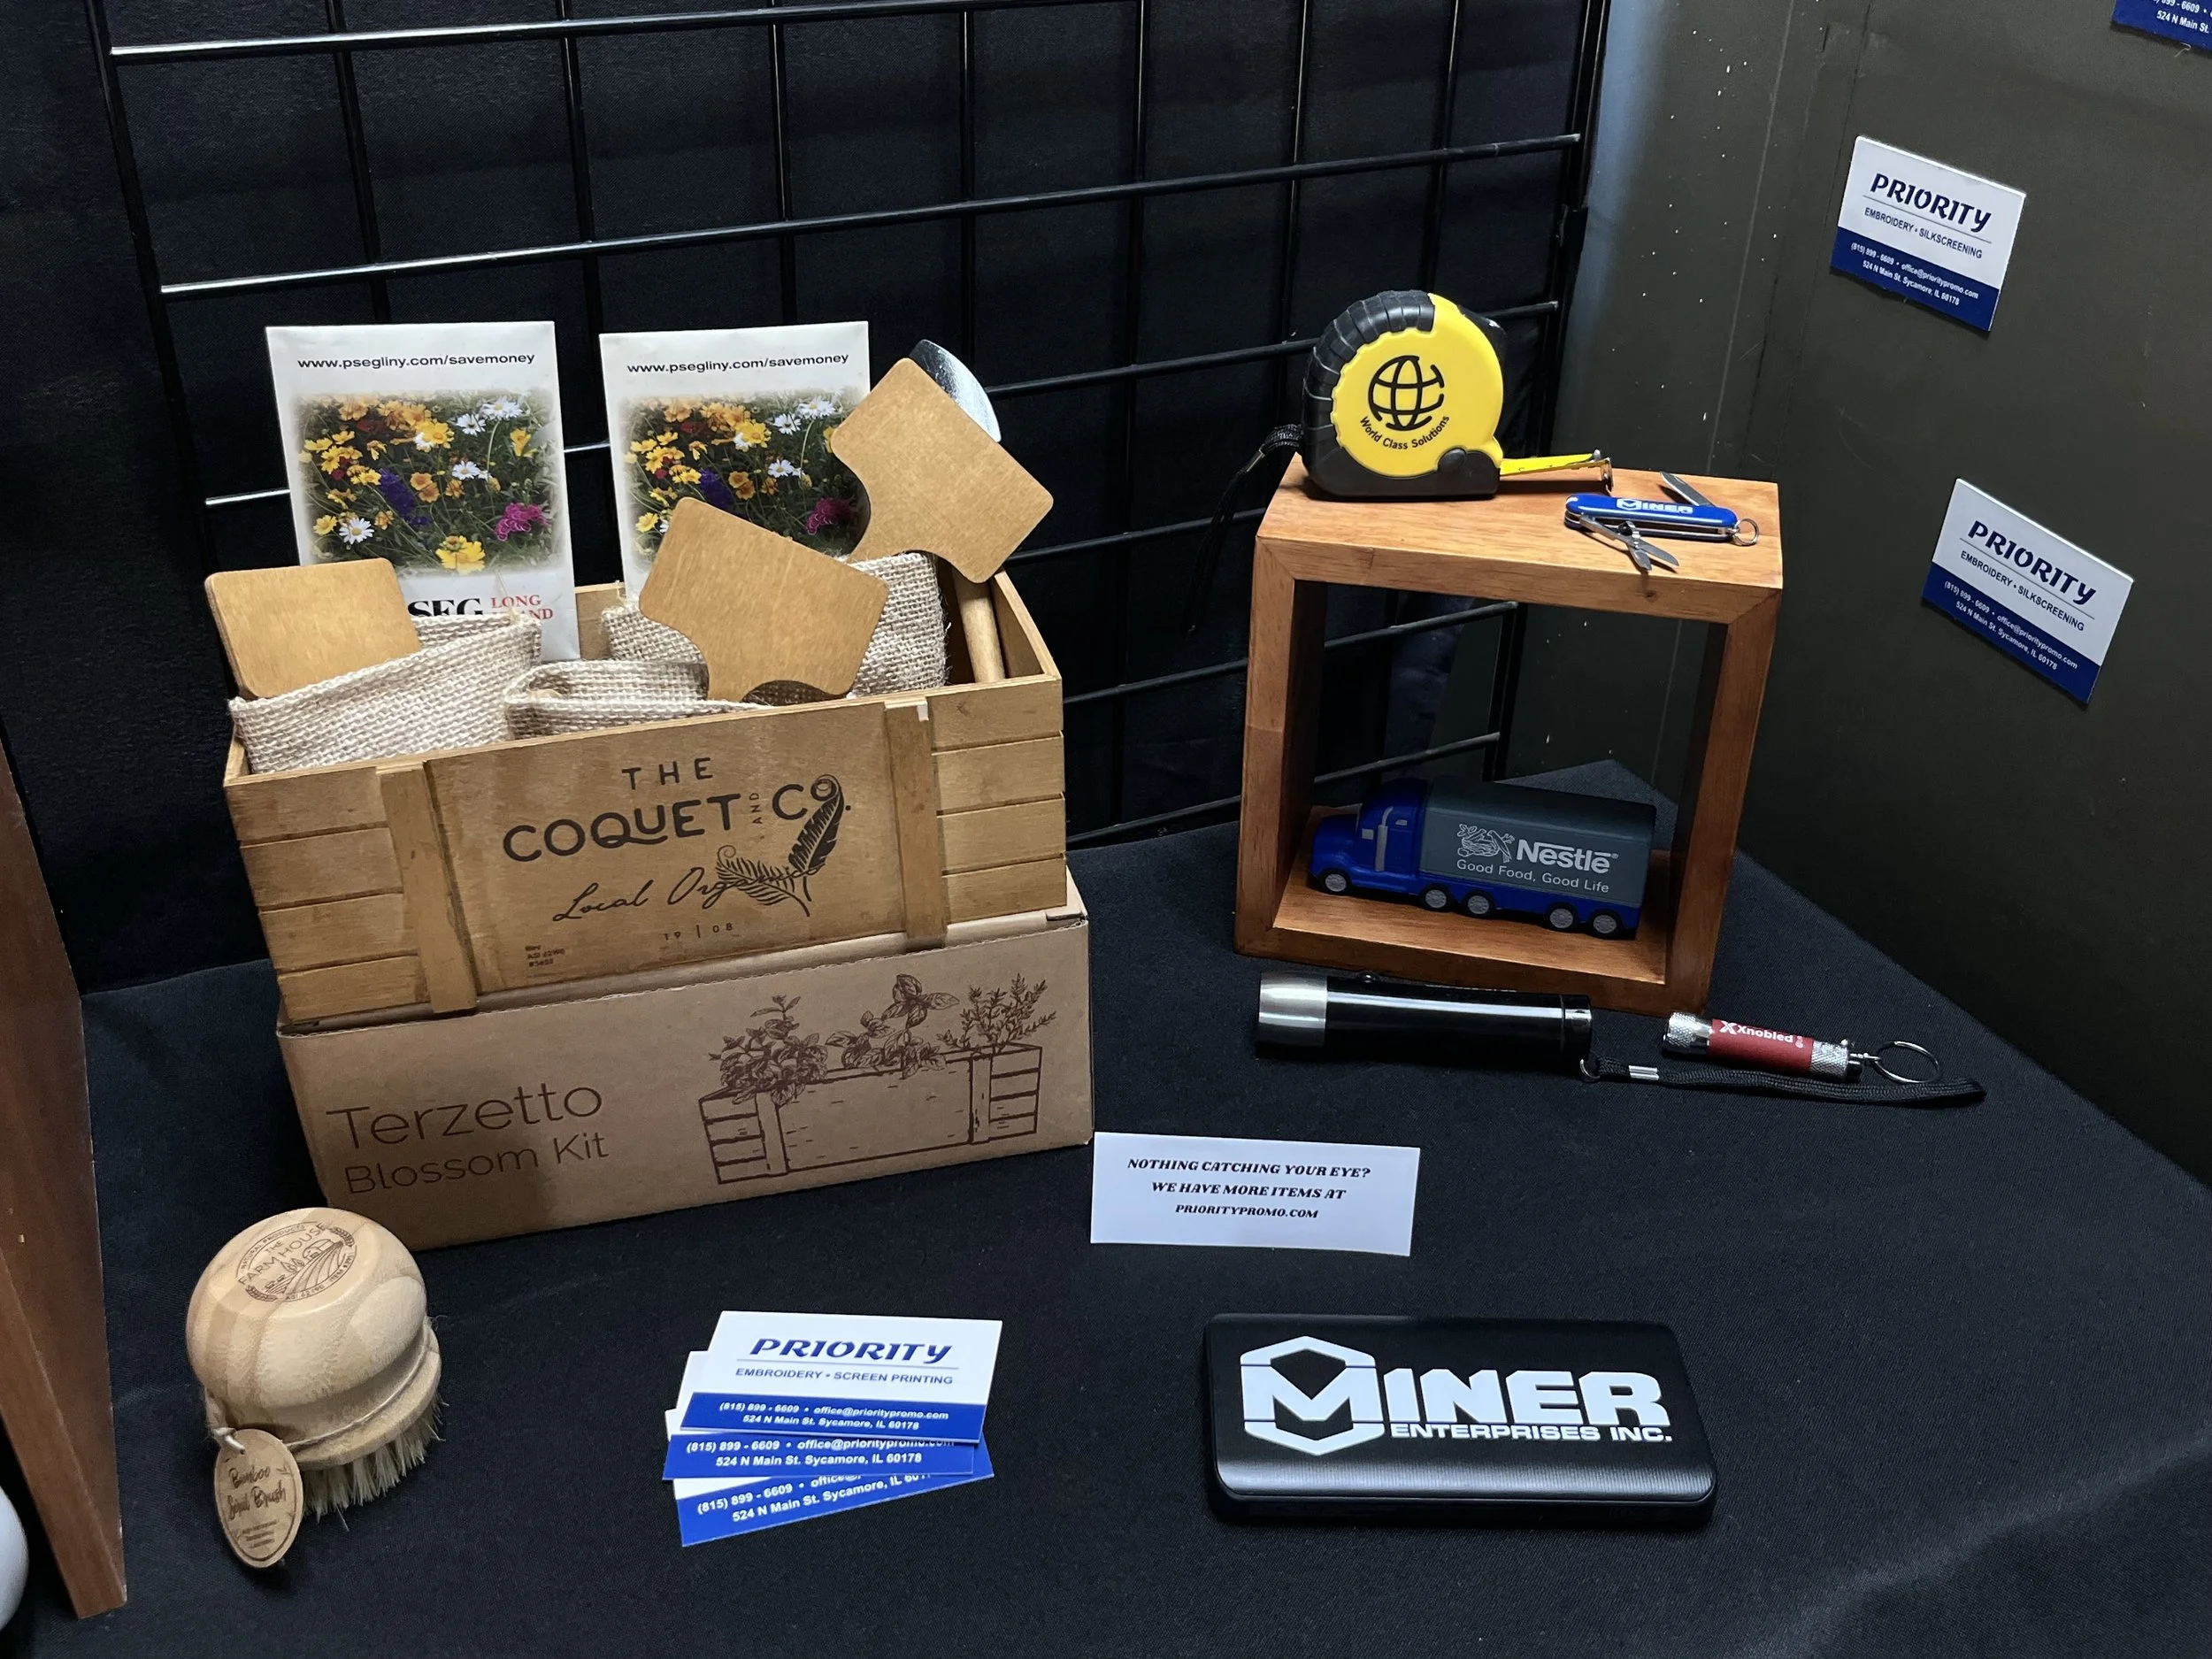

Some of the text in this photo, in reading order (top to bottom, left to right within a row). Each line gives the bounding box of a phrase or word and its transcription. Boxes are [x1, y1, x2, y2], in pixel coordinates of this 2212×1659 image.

[2181, 1, 2200, 13] 6609
[2156, 10, 2209, 34] 524 N Main St.
[1870, 173, 1992, 233] PRIORITY
[1864, 207, 1983, 259] EMBROIDERY SILKSCREENING
[1863, 260, 1873, 270] 524
[1873, 264, 1878, 273] N
[1878, 266, 1893, 279] Main
[1902, 276, 1933, 296] Sycamore,
[1934, 289, 1940, 298] IL
[297, 353, 535, 370] www.psegliny.com/savemoney
[627, 352, 849, 373] www.psegliny.com/savemoney
[1360, 416, 1449, 449] World Class Solutions
[1968, 520, 2096, 605] PRIORITY
[491, 594, 541, 609] LONG
[1961, 550, 2084, 631] EMBROIDERY SILKSCREENING
[407, 598, 483, 617] SEG
[1955, 601, 1966, 612] 524
[1967, 607, 1972, 617] N
[1973, 611, 1988, 626] Main
[1998, 627, 2030, 654] Sycamore,
[2031, 649, 2037, 658] IL
[1997, 615, 2078, 670] office@prioritypromo.com
[621, 757, 713, 790] THE
[503, 793, 741, 862] COQUET
[751, 792, 761, 825] AND
[1456, 859, 1609, 893] Good Food, Good Life
[552, 879, 653, 921] Local
[326, 1083, 602, 1149] Terzetto
[345, 1132, 610, 1194] Blossom Kit
[1127, 1158, 1371, 1179] NOTHING CATCHING YOUR EYE?
[1152, 1182, 1347, 1201] WE HAVE MORE ITEMS AT
[1175, 1204, 1319, 1219] PRIORITYPROMO.COM
[265, 1240, 283, 1253] THE
[749, 1338, 953, 1363] PRIORITY
[735, 1368, 954, 1386] EMBROIDERY SCREEN PRINTING
[1240, 1335, 1671, 1456] MINER
[719, 1402, 745, 1412] (815)
[774, 1404, 800, 1413] 6609
[813, 1406, 949, 1420] office@prioritypromo.com
[774, 1416, 800, 1425] Main
[802, 1417, 816, 1425] St.
[818, 1417, 873, 1429] Sycamore,
[687, 1442, 716, 1454] (815)
[719, 1441, 741, 1451] 899
[751, 1440, 780, 1450] 6609
[1391, 1423, 1672, 1442] ENTERPRISES INC.
[716, 1453, 922, 1467] 524 N Main St. Sycamore, IL 60178
[250, 1479, 287, 1508] Brush
[697, 1498, 728, 1515] (815)
[731, 1492, 754, 1506] 899
[764, 1483, 793, 1499] 6609
[732, 1509, 755, 1522] 524
[757, 1506, 767, 1516] N
[771, 1500, 800, 1513] Main
[803, 1495, 820, 1506] St.
[822, 1480, 888, 1502] Sycamore,
[890, 1476, 902, 1486] IL
